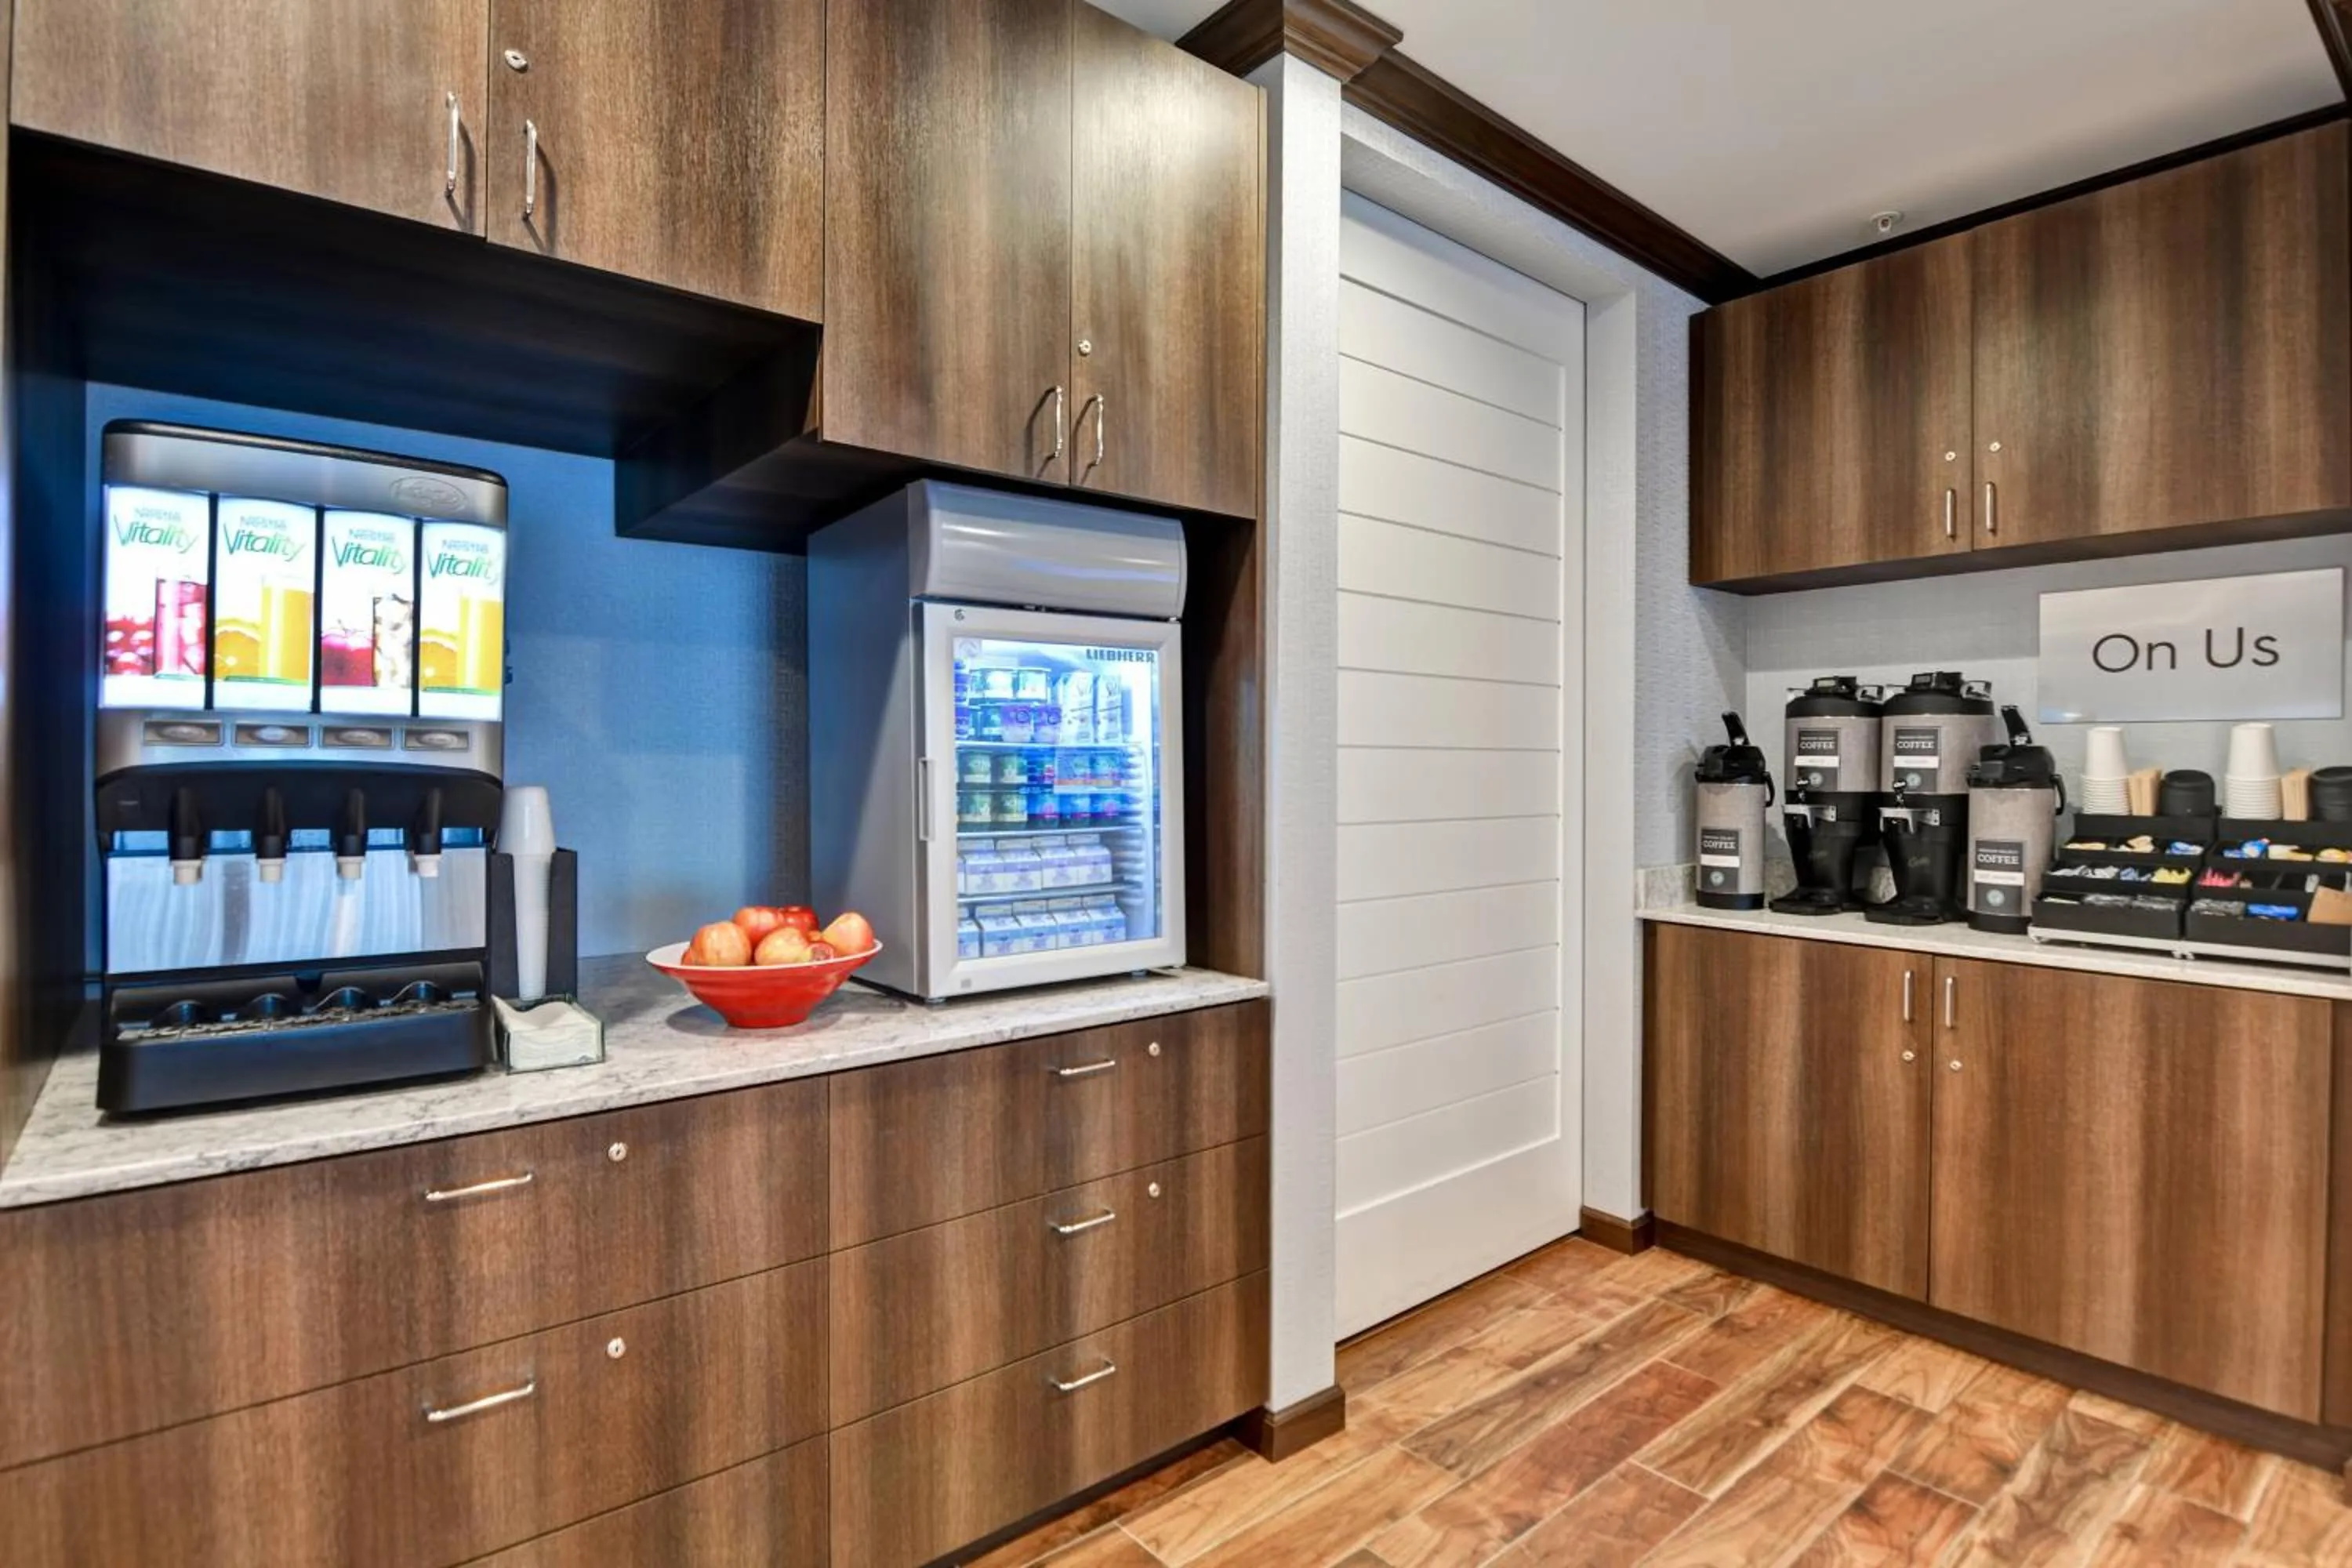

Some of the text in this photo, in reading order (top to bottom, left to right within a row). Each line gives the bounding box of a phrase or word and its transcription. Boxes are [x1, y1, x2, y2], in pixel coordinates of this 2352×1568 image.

[113, 514, 199, 554] Vitality
[223, 522, 306, 562] Vitality
[332, 535, 406, 575] Vitality
[426, 546, 500, 586] Vitality
[1086, 648, 1155, 662] LIEBHERR
[2092, 627, 2280, 673] On Us
[1800, 741, 1835, 750] COFFEE
[1896, 741, 1935, 750] COFFEE
[1703, 840, 1737, 850] COFFEE
[1976, 853, 2020, 865] COFFEE
